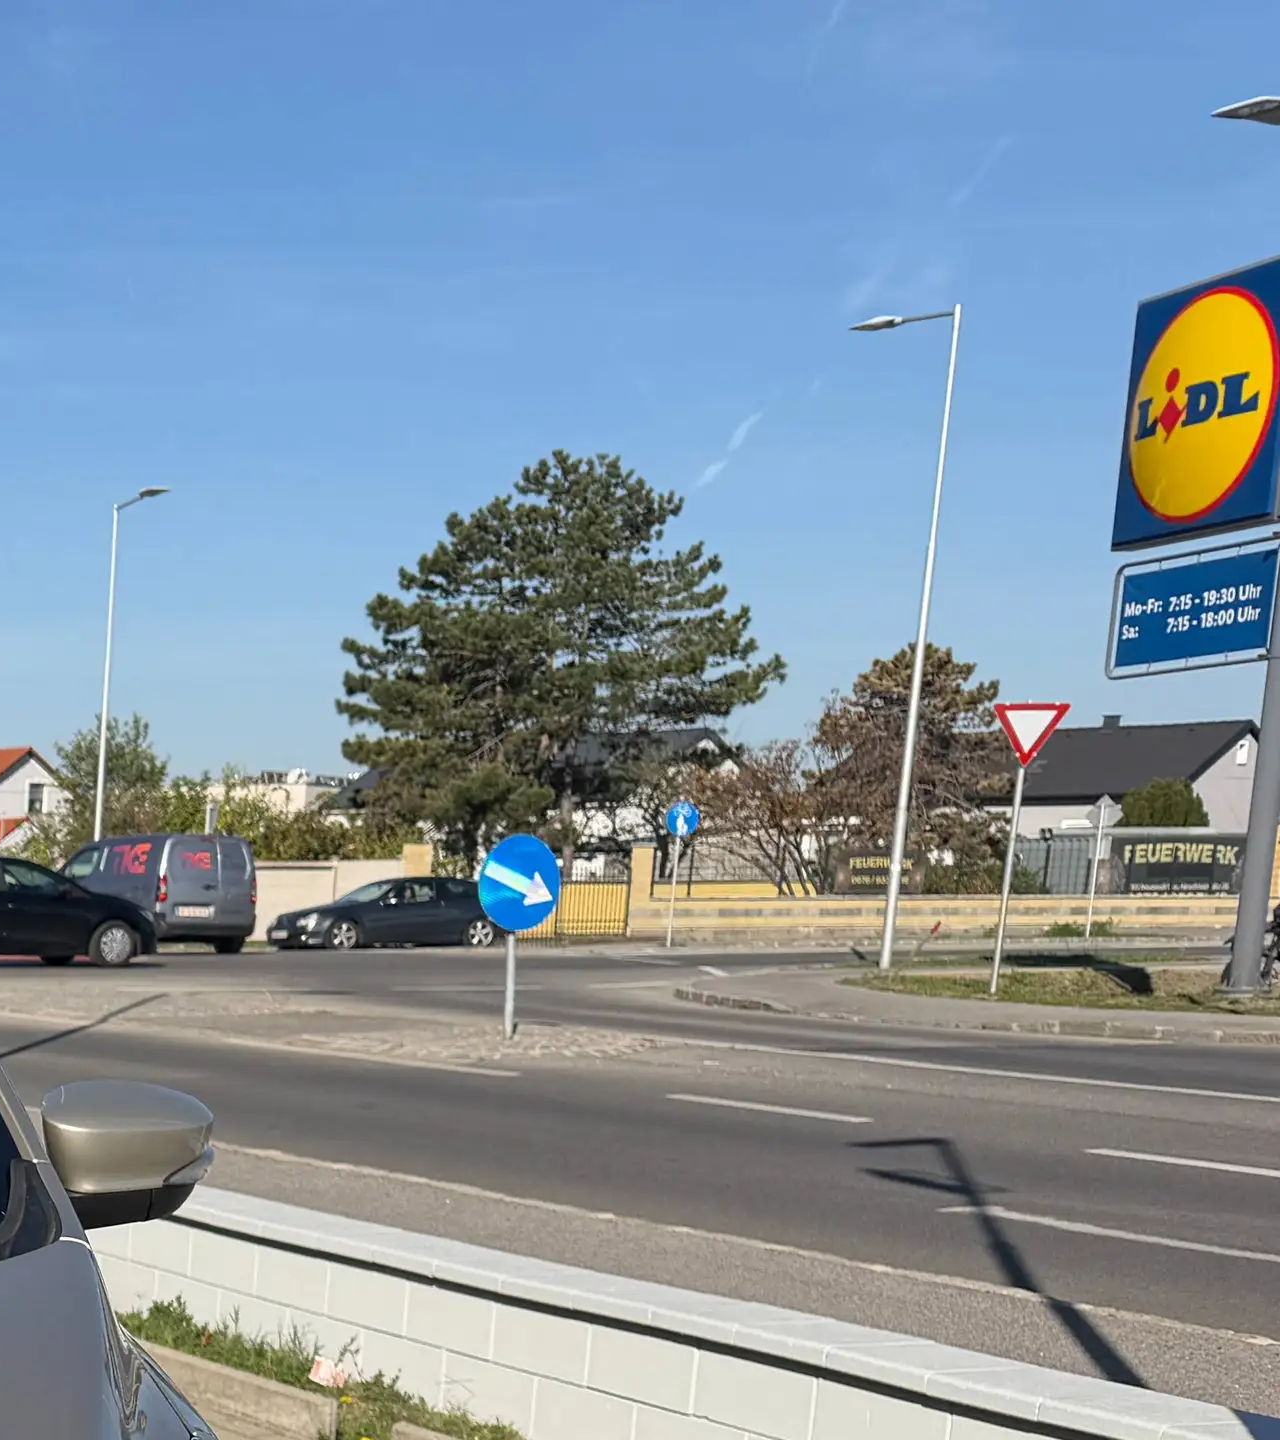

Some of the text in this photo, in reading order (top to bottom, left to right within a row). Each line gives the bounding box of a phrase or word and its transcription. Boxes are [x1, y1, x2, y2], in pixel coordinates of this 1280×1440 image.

[1123, 598, 1163, 618] Mo-Fr:
[1167, 593, 1193, 613] 7:15
[1202, 587, 1236, 607] 19:30
[1238, 584, 1264, 602] Uhr
[1121, 625, 1140, 640] Sa:
[1166, 614, 1190, 634] 7:15
[1200, 609, 1235, 628] 18:00
[1237, 606, 1262, 623] Uhr
